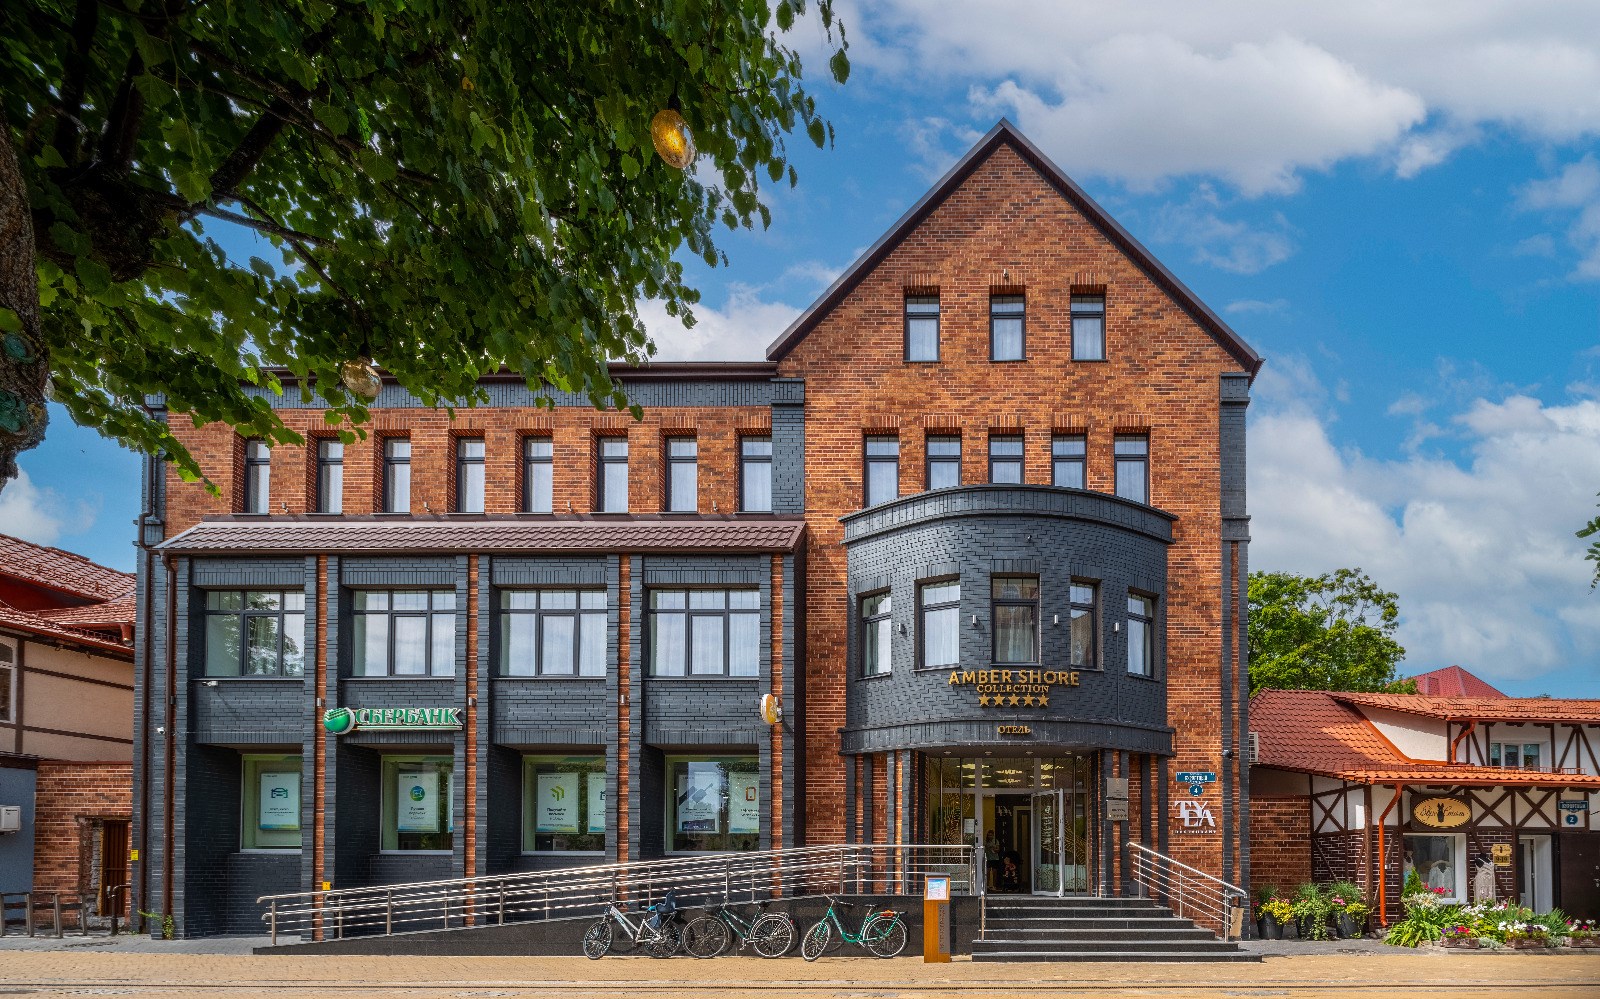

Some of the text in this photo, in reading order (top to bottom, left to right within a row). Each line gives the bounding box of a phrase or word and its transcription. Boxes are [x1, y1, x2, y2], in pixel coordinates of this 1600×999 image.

[948, 669, 1080, 686] AMBER SHORE
[976, 684, 1050, 693] COLLECTION
[355, 707, 461, 725] СБЕРБАНК
[997, 725, 1032, 735] ОТЕЛЬ
